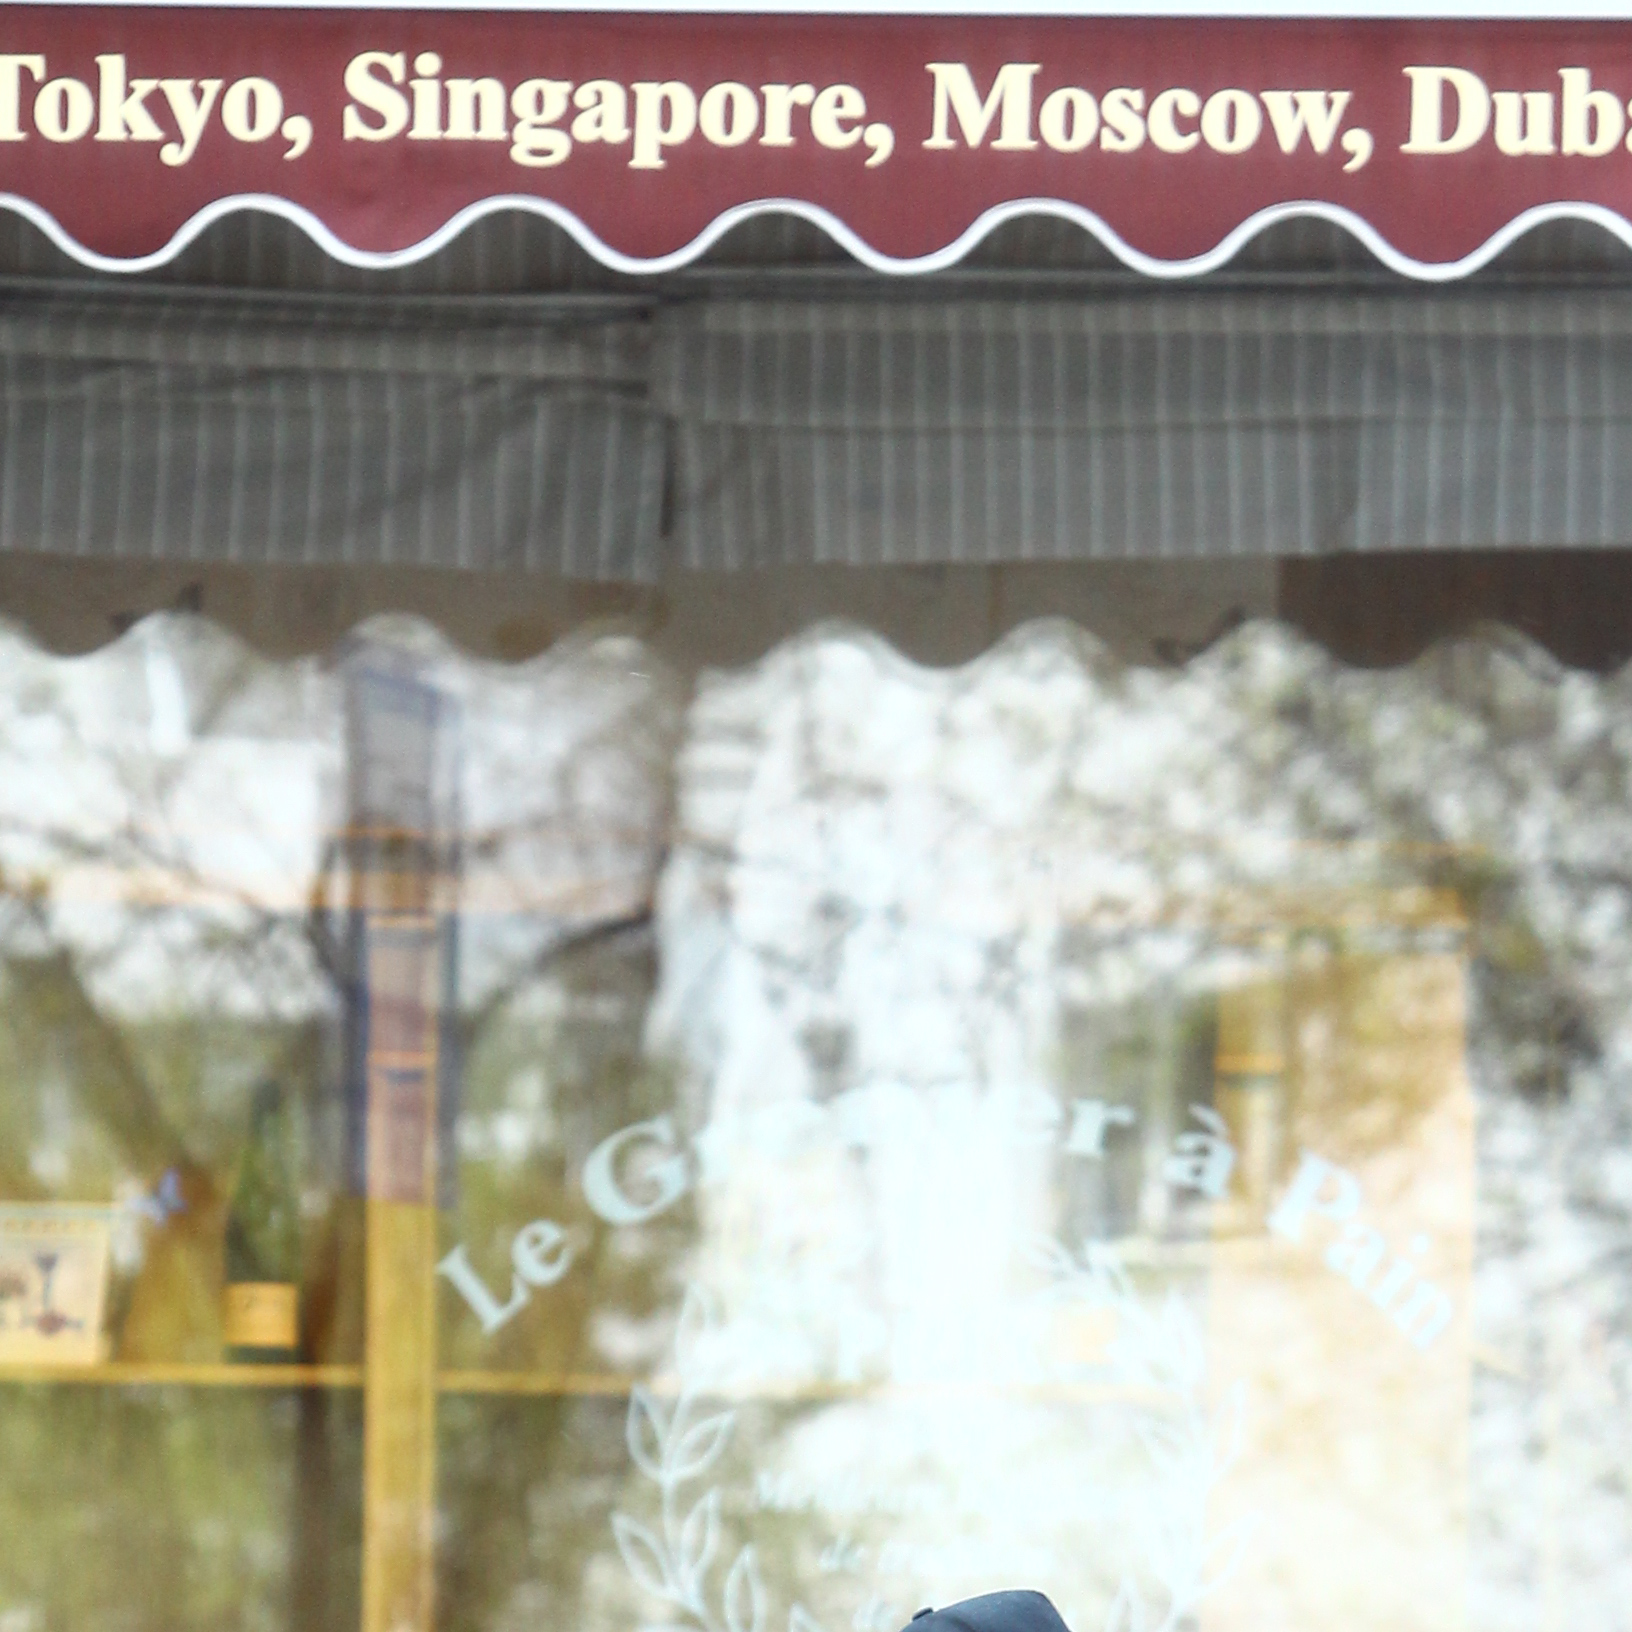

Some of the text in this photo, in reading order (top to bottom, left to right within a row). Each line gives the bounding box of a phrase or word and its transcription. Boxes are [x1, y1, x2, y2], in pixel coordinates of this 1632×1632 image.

[0, 53, 314, 167] Tokyo,
[342, 51, 896, 169] Singapore,
[922, 61, 1374, 173] Moscow,
[437, 1219, 577, 1335] Le
[1267, 1150, 1453, 1351] Pain
